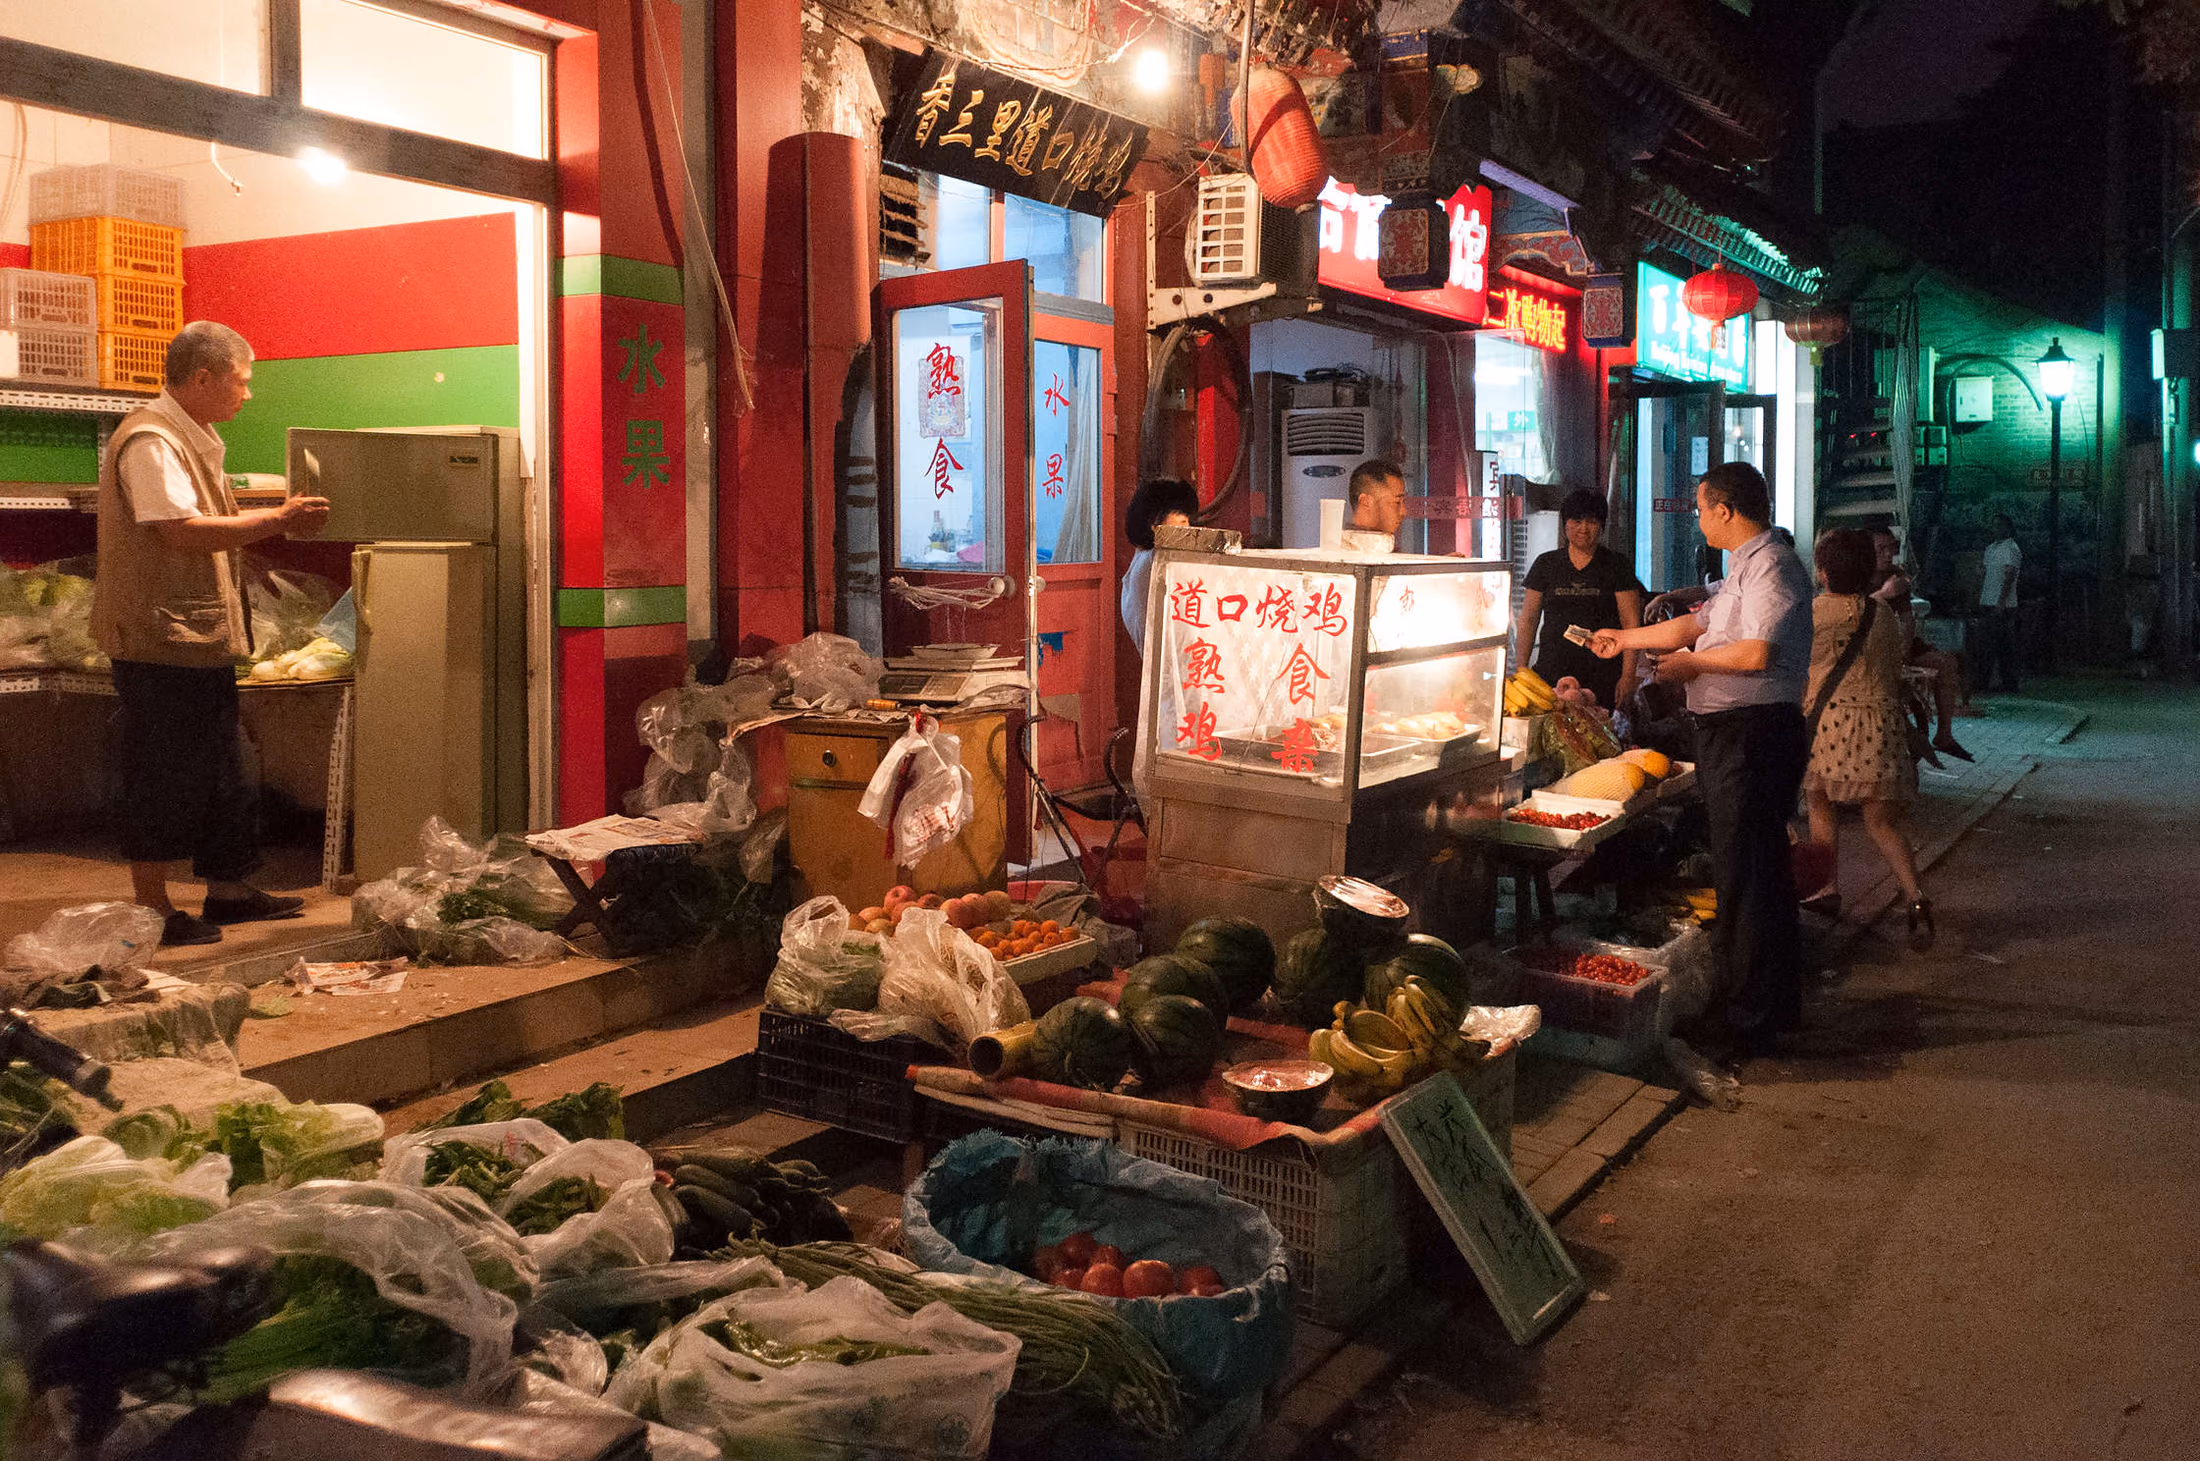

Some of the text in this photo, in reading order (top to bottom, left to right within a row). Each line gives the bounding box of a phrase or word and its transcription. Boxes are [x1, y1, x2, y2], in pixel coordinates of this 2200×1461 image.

[617, 322, 670, 489] 水果
[924, 342, 964, 500] 熟食
[1042, 373, 1071, 499] 水果
[1170, 577, 1348, 637] 道口烧鸡
[1182, 636, 1331, 705] 熟食
